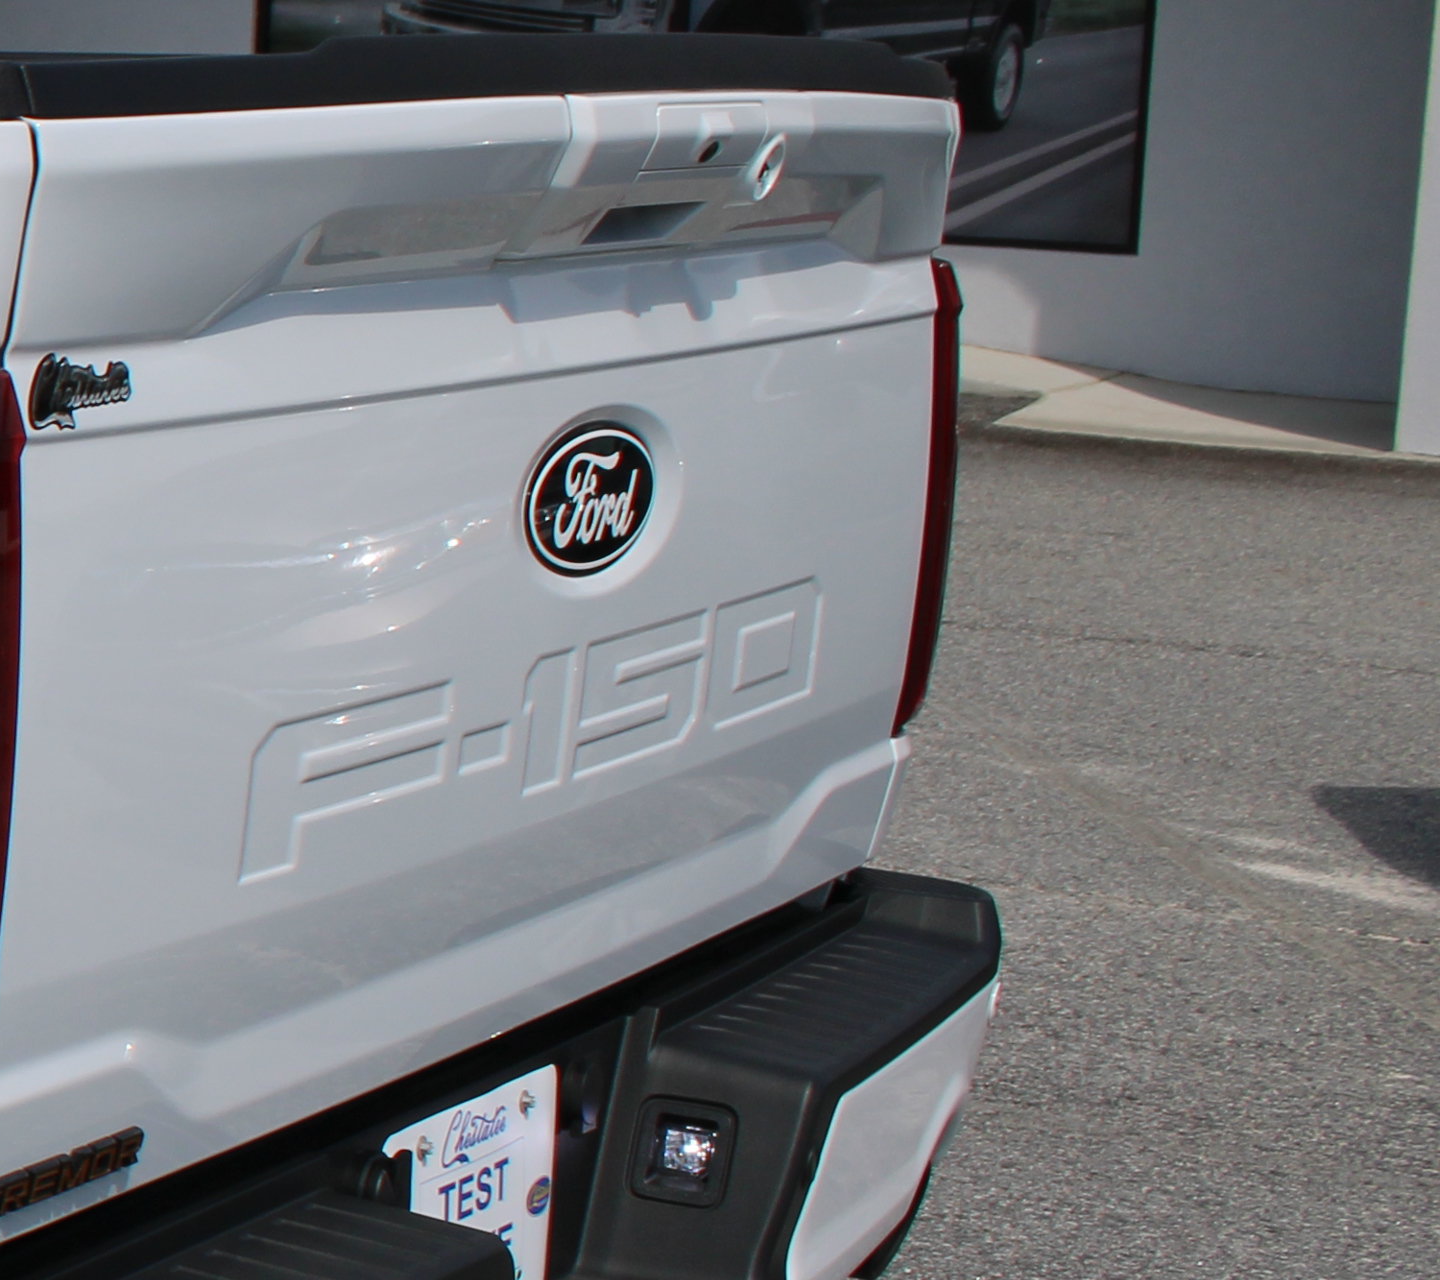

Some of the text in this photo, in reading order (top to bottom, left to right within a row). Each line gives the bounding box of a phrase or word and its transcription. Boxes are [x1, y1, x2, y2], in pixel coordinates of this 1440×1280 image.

[554, 451, 638, 549] Ford
[238, 576, 824, 886] F-150
[438, 1157, 509, 1221] TEST
